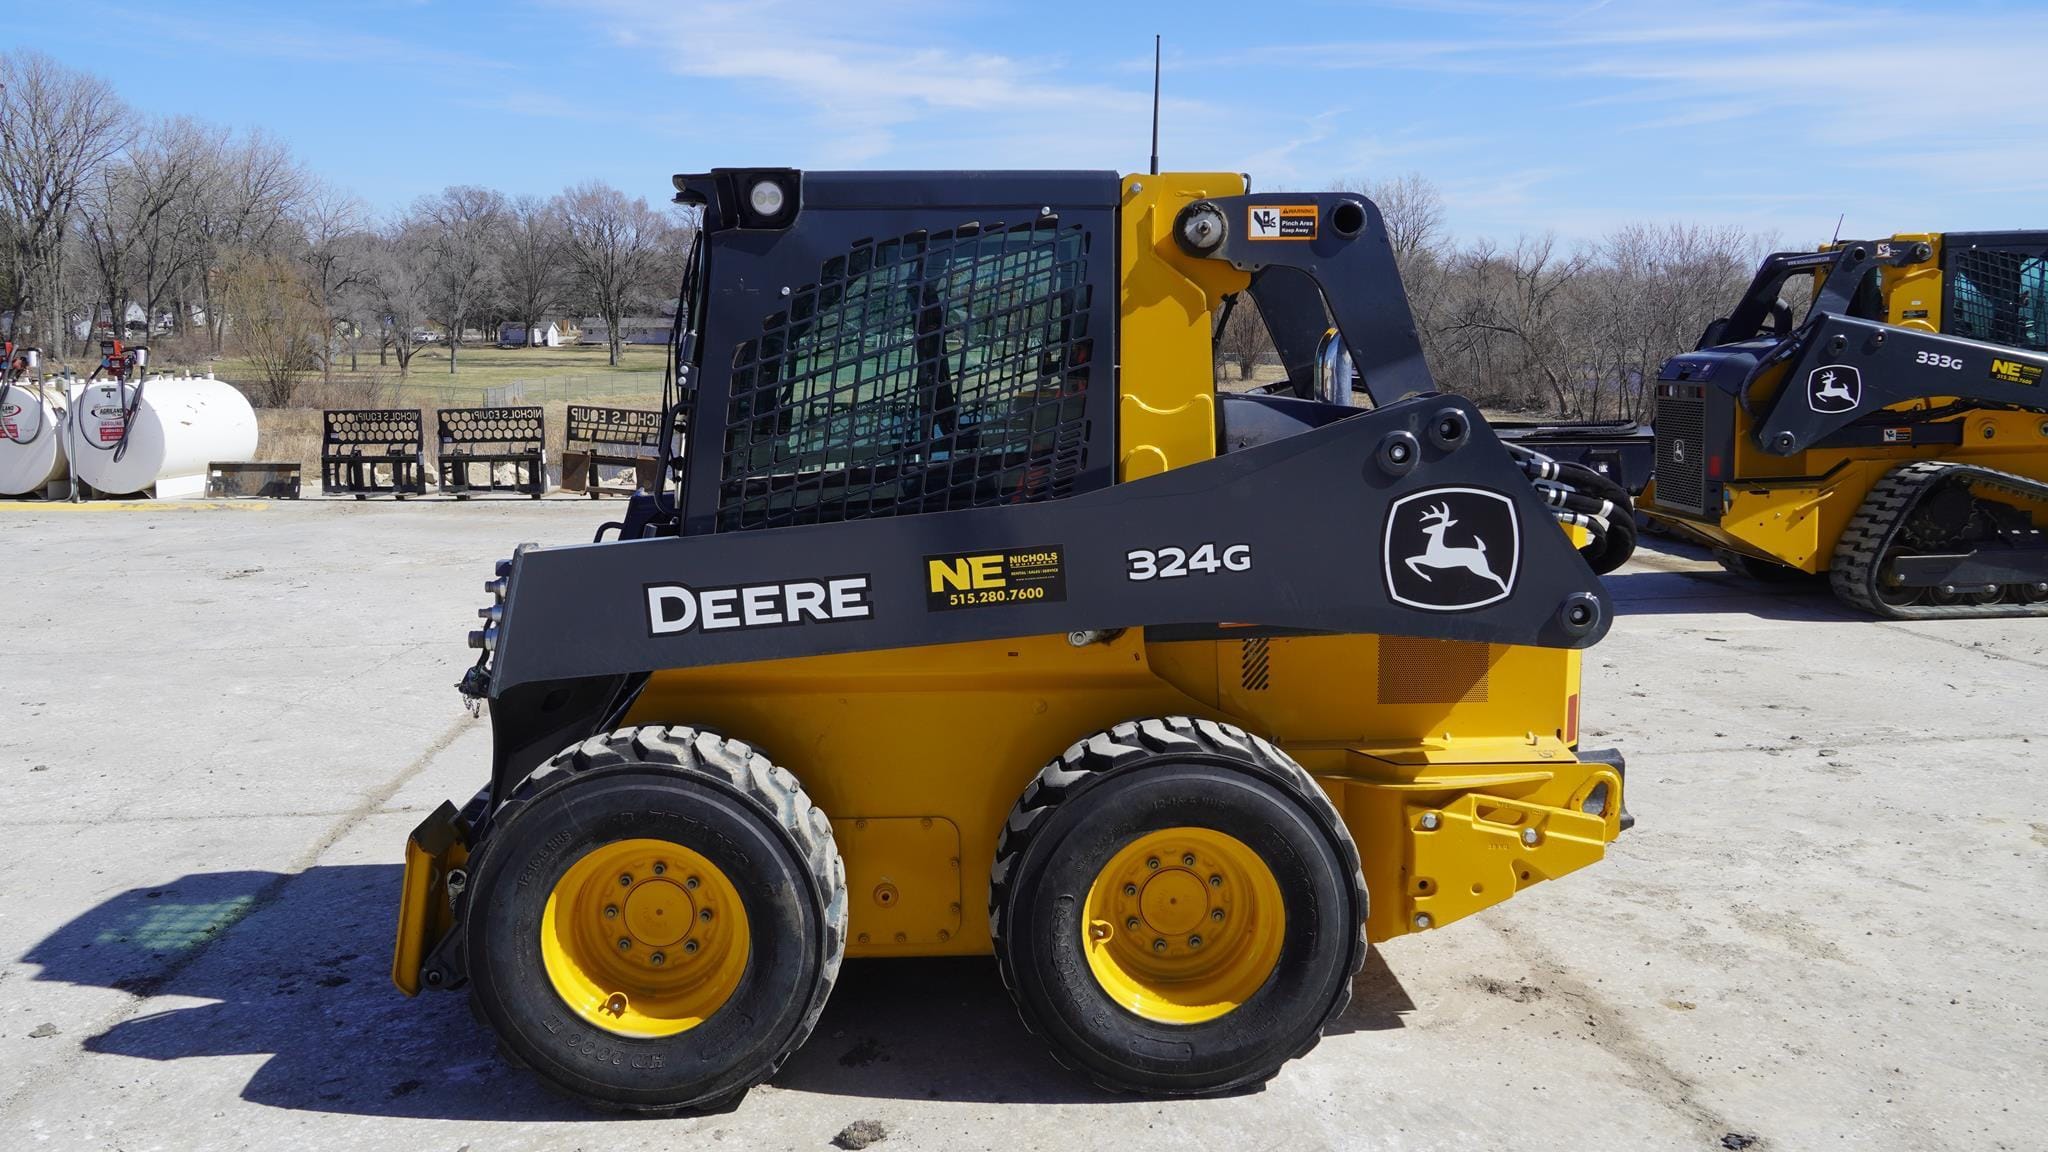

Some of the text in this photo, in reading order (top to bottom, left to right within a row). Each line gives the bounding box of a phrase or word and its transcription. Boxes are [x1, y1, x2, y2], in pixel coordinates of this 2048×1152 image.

[1916, 351, 1963, 371] 333G
[1991, 359, 2022, 377] NE
[106, 391, 111, 399] 4
[1009, 552, 1058, 564] NICHOLS
[1127, 544, 1251, 580] 324G
[929, 554, 1006, 593] NE
[950, 587, 1044, 605] 515.280.7600
[647, 577, 869, 635] DEERE
